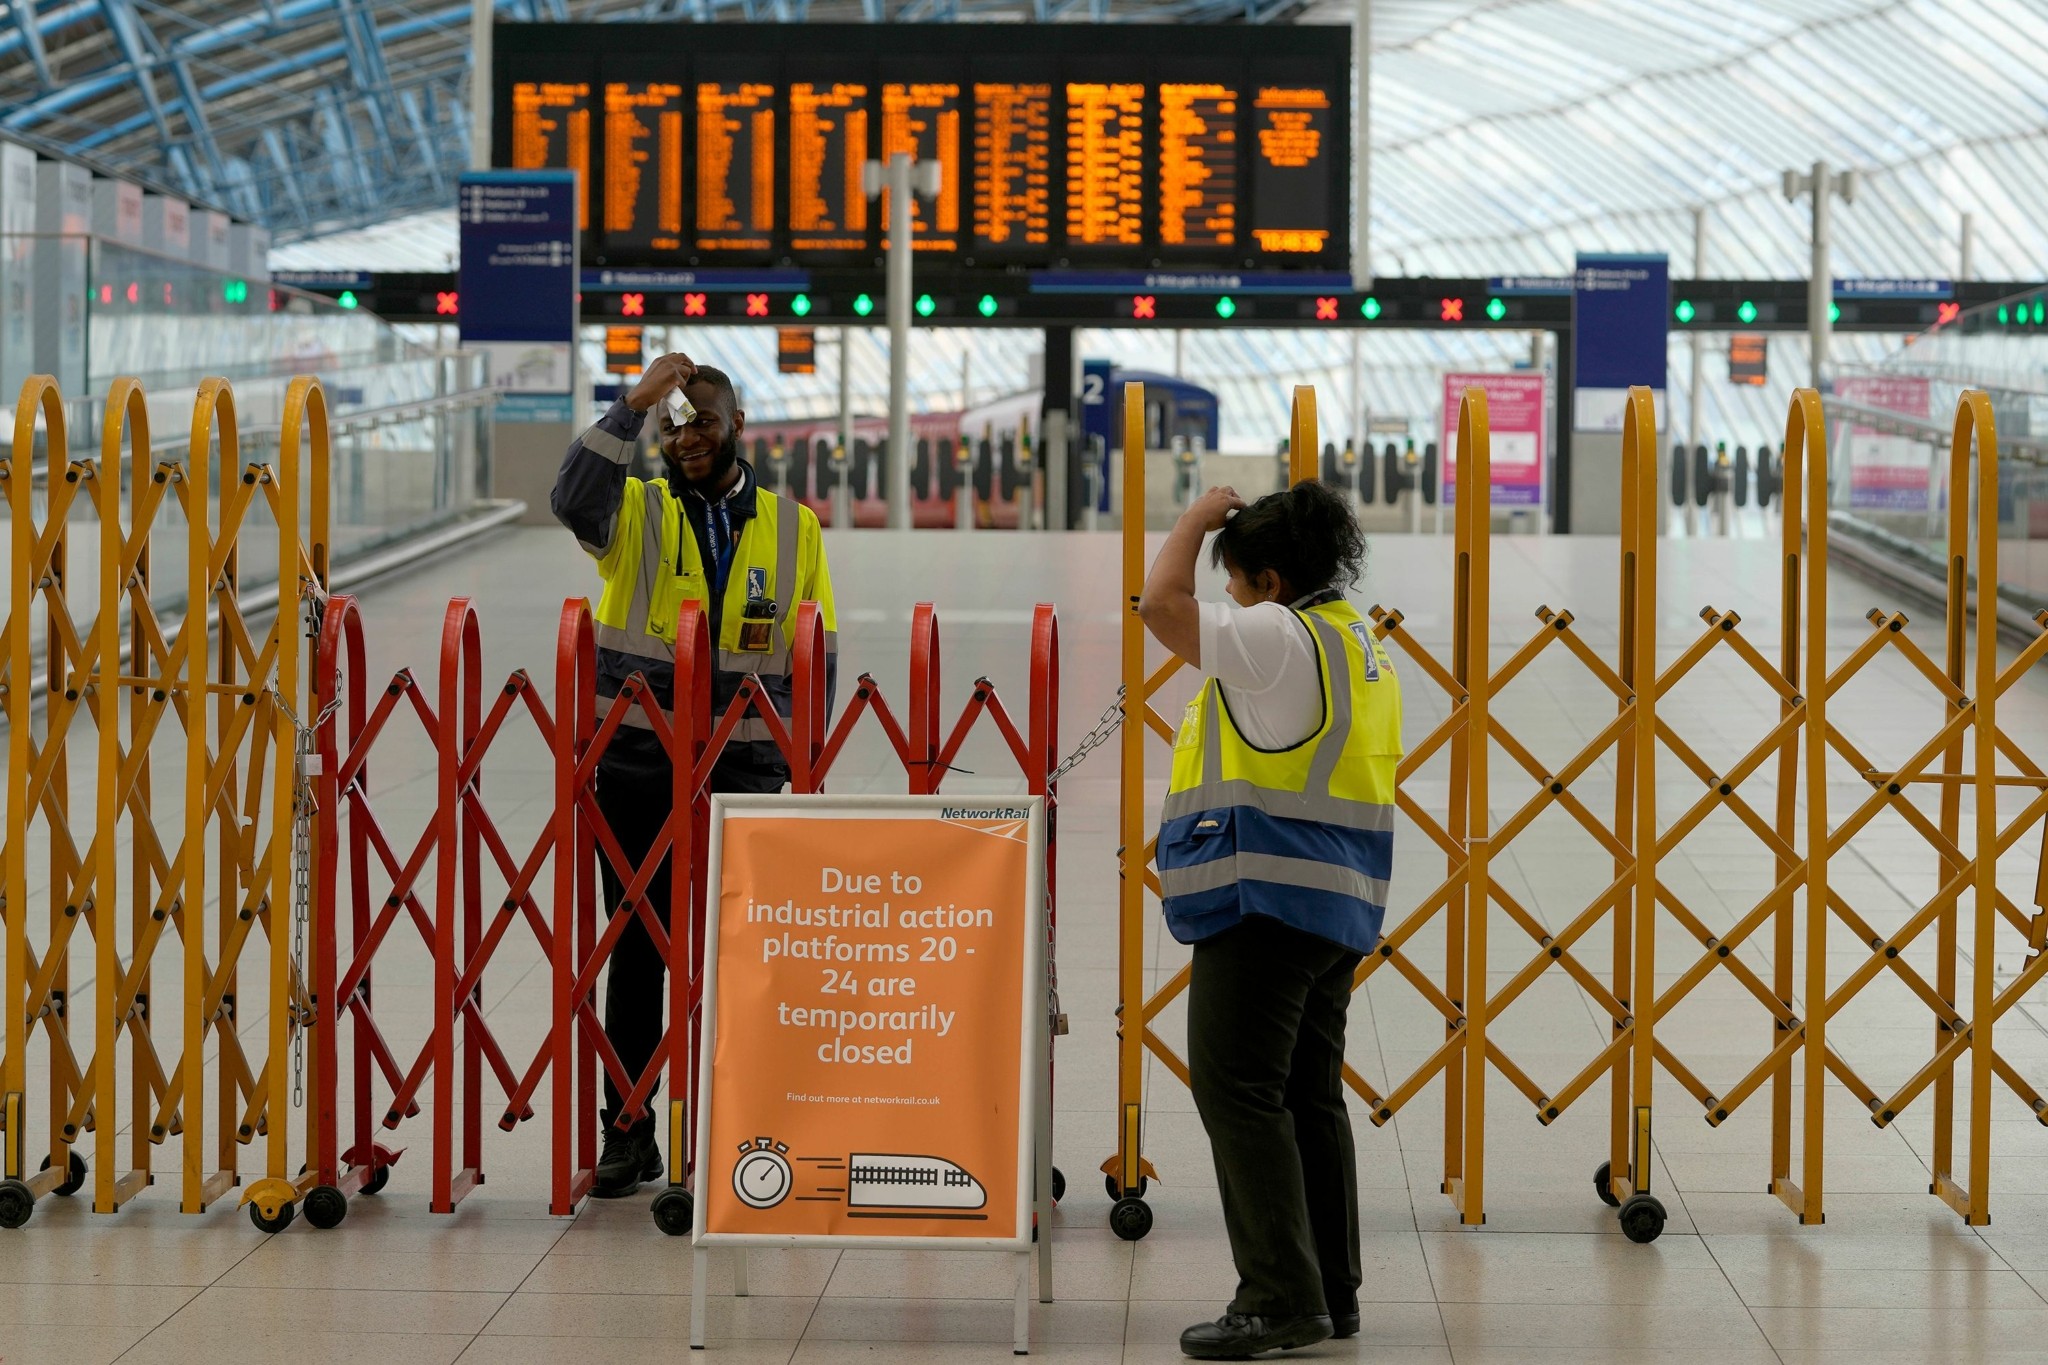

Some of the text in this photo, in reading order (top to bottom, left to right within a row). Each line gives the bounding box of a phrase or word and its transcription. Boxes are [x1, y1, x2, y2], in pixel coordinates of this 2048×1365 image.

[1083, 373, 1104, 405] 2
[941, 807, 1030, 819] NetworkRail
[821, 867, 922, 895] Due to
[747, 898, 993, 928] industrial action
[763, 932, 910, 963] platforms
[919, 936, 957, 962] 20
[820, 968, 916, 996] 24 are
[777, 1002, 956, 1037] temporarily
[817, 1037, 913, 1065] closed
[786, 1092, 941, 1106] Find out more at networkrail.co.uk
